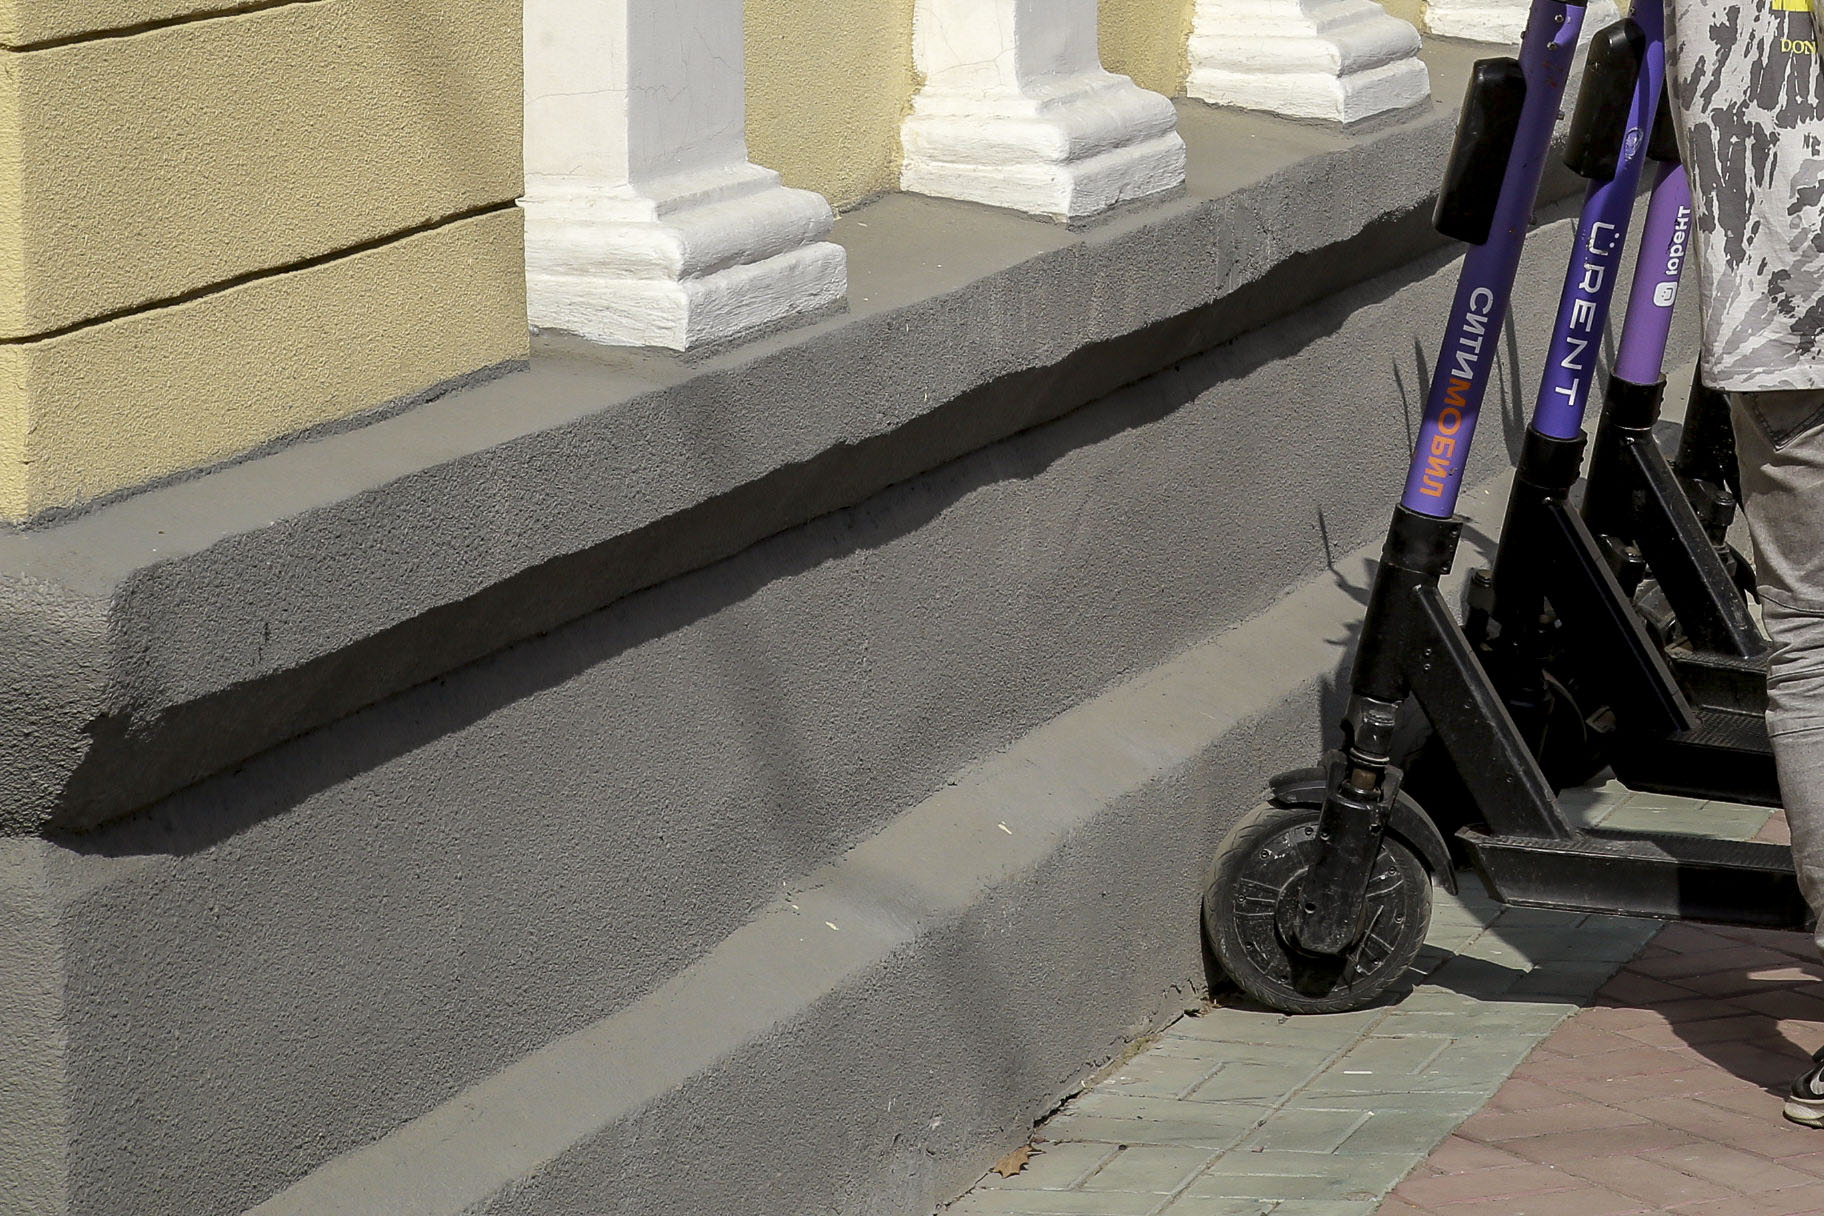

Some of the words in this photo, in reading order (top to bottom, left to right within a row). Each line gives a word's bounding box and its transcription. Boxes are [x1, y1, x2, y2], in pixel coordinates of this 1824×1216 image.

[1554, 220, 1620, 407] ÜRENT
[1665, 205, 1691, 276] юрент
[1419, 286, 1494, 498] СИТИМОБИЛ
